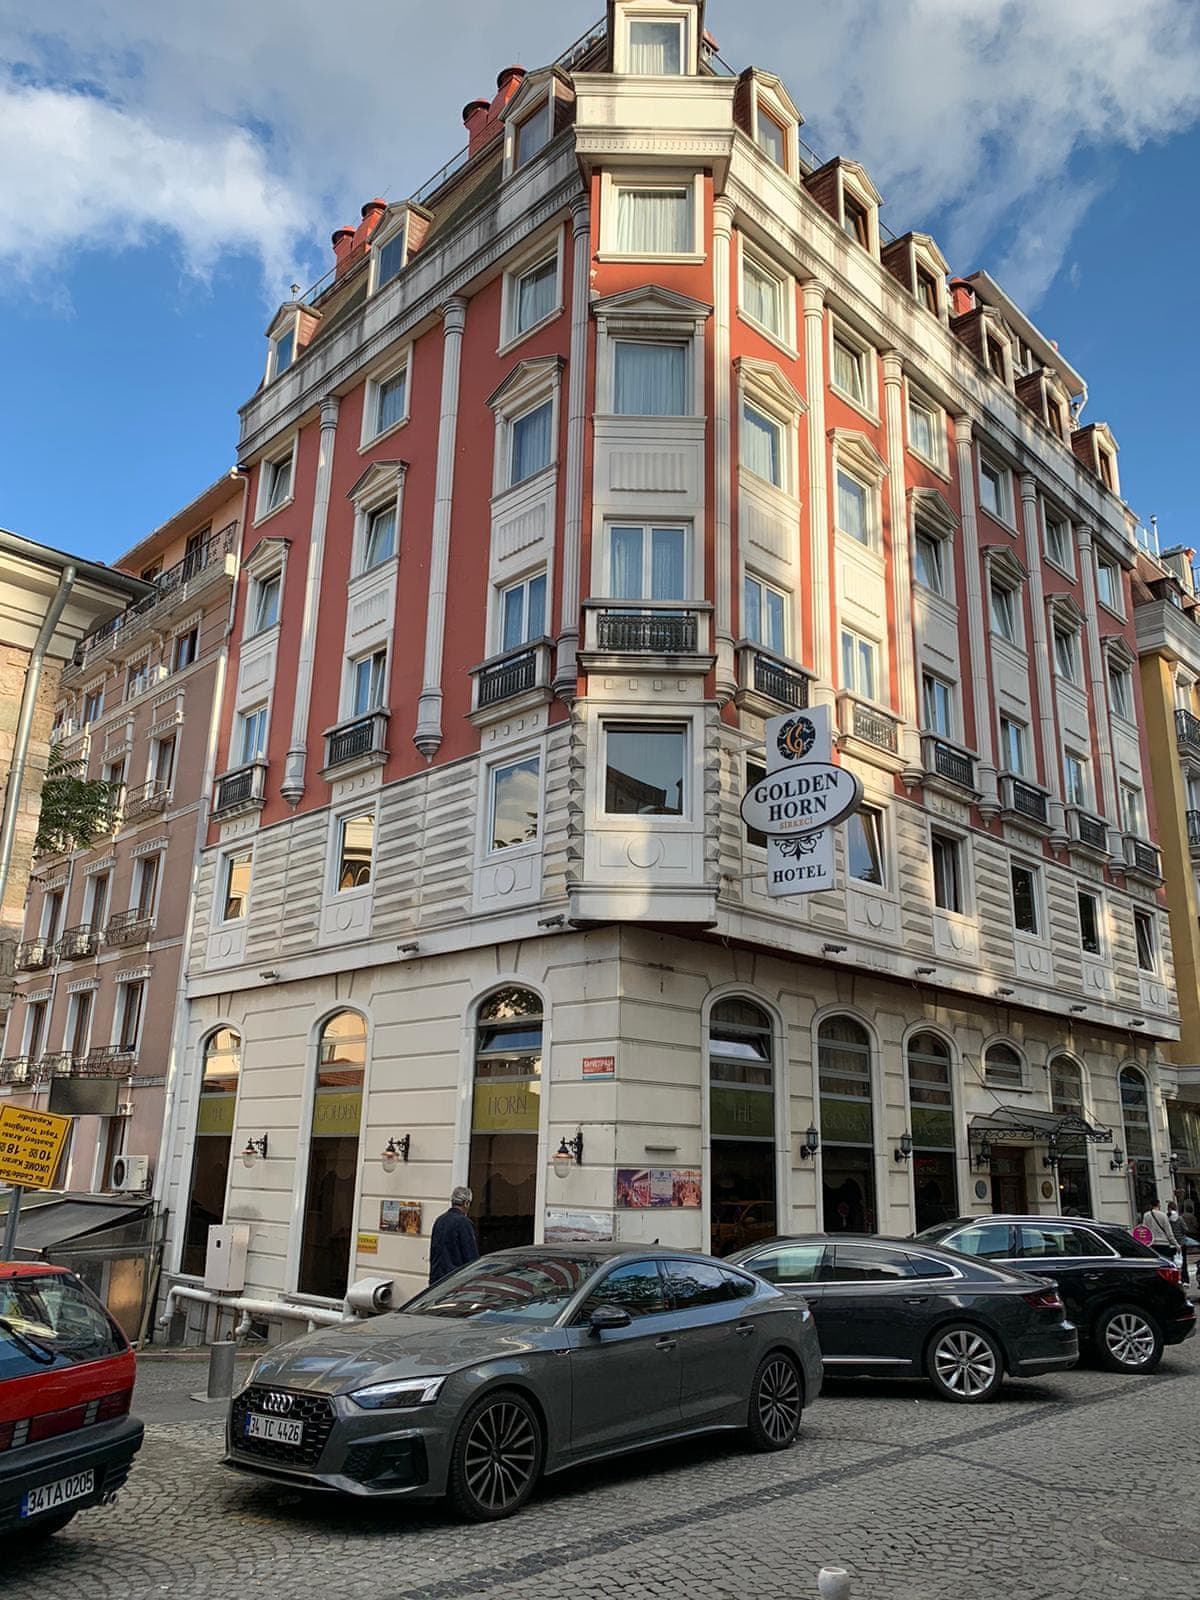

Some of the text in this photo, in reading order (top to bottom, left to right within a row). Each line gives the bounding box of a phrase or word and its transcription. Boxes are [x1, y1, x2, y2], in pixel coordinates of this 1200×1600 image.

[754, 771, 839, 804] GOLDEN
[769, 794, 827, 822] HORN
[773, 864, 826, 883] HOTEL
[488, 1095, 528, 1116] HORN
[249, 1417, 300, 1442] 34 TC 4426
